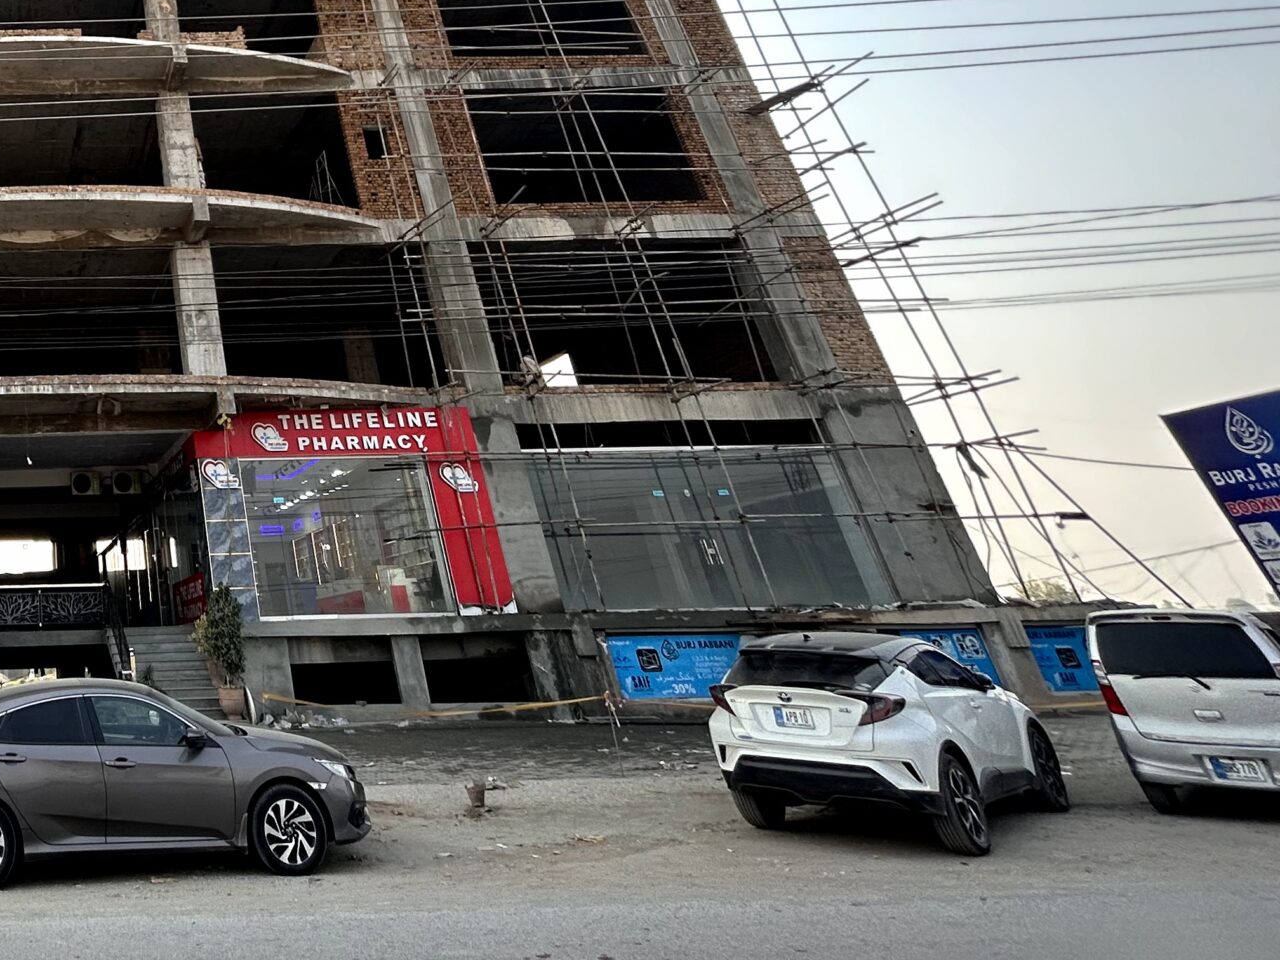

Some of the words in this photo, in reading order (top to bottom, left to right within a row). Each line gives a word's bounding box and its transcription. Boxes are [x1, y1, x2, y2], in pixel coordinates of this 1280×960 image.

[277, 414, 324, 430] THE
[329, 411, 438, 429] LIFELINE
[297, 435, 426, 451] PHARMACY
[1208, 467, 1256, 486] BURJ
[1247, 480, 1280, 491] PESH
[675, 640, 696, 650] BURJ
[698, 640, 735, 649] RABBANI
[671, 683, 696, 695] 30%
